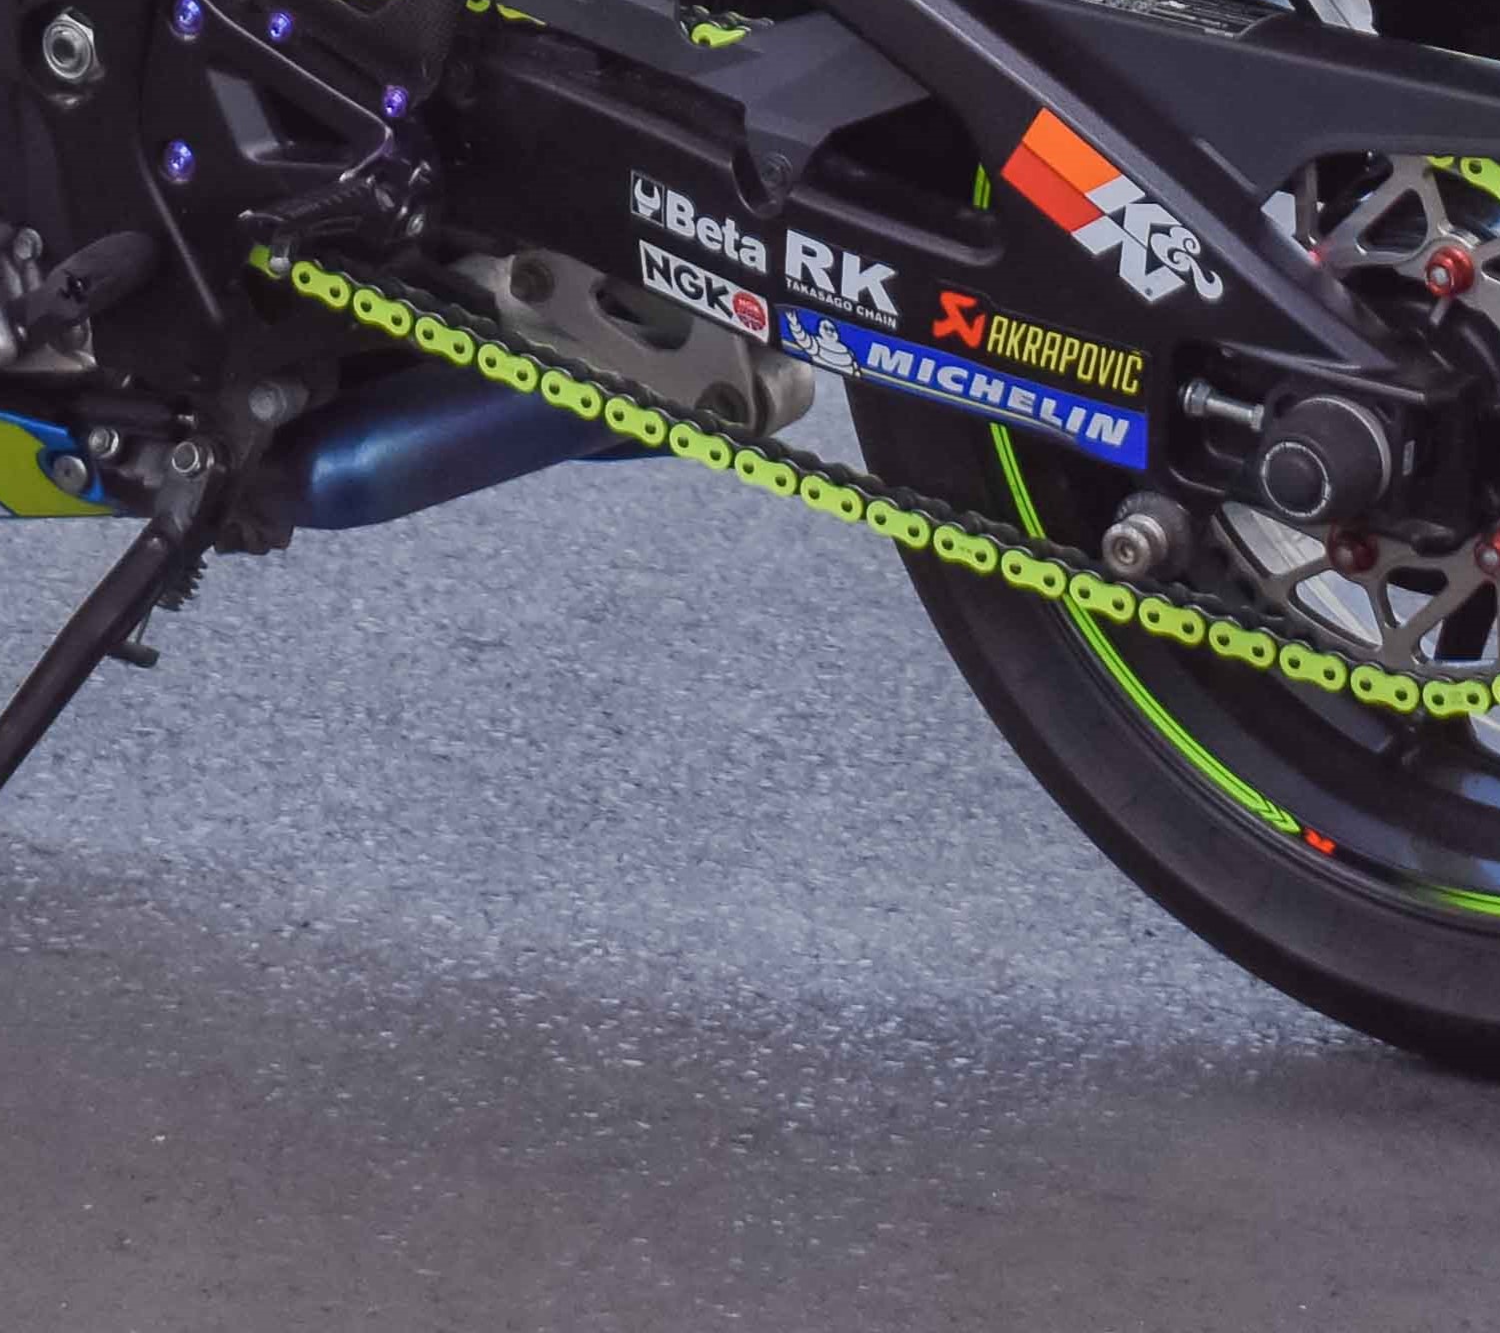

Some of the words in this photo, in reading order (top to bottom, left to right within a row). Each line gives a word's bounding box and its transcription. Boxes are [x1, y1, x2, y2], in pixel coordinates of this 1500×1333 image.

[665, 188, 767, 275] Beta
[785, 228, 899, 317] RK
[643, 240, 735, 321] NGK
[785, 277, 853, 312] TAKASAGO
[855, 304, 898, 330] CHAIN
[866, 342, 1130, 447] MICHELIN
